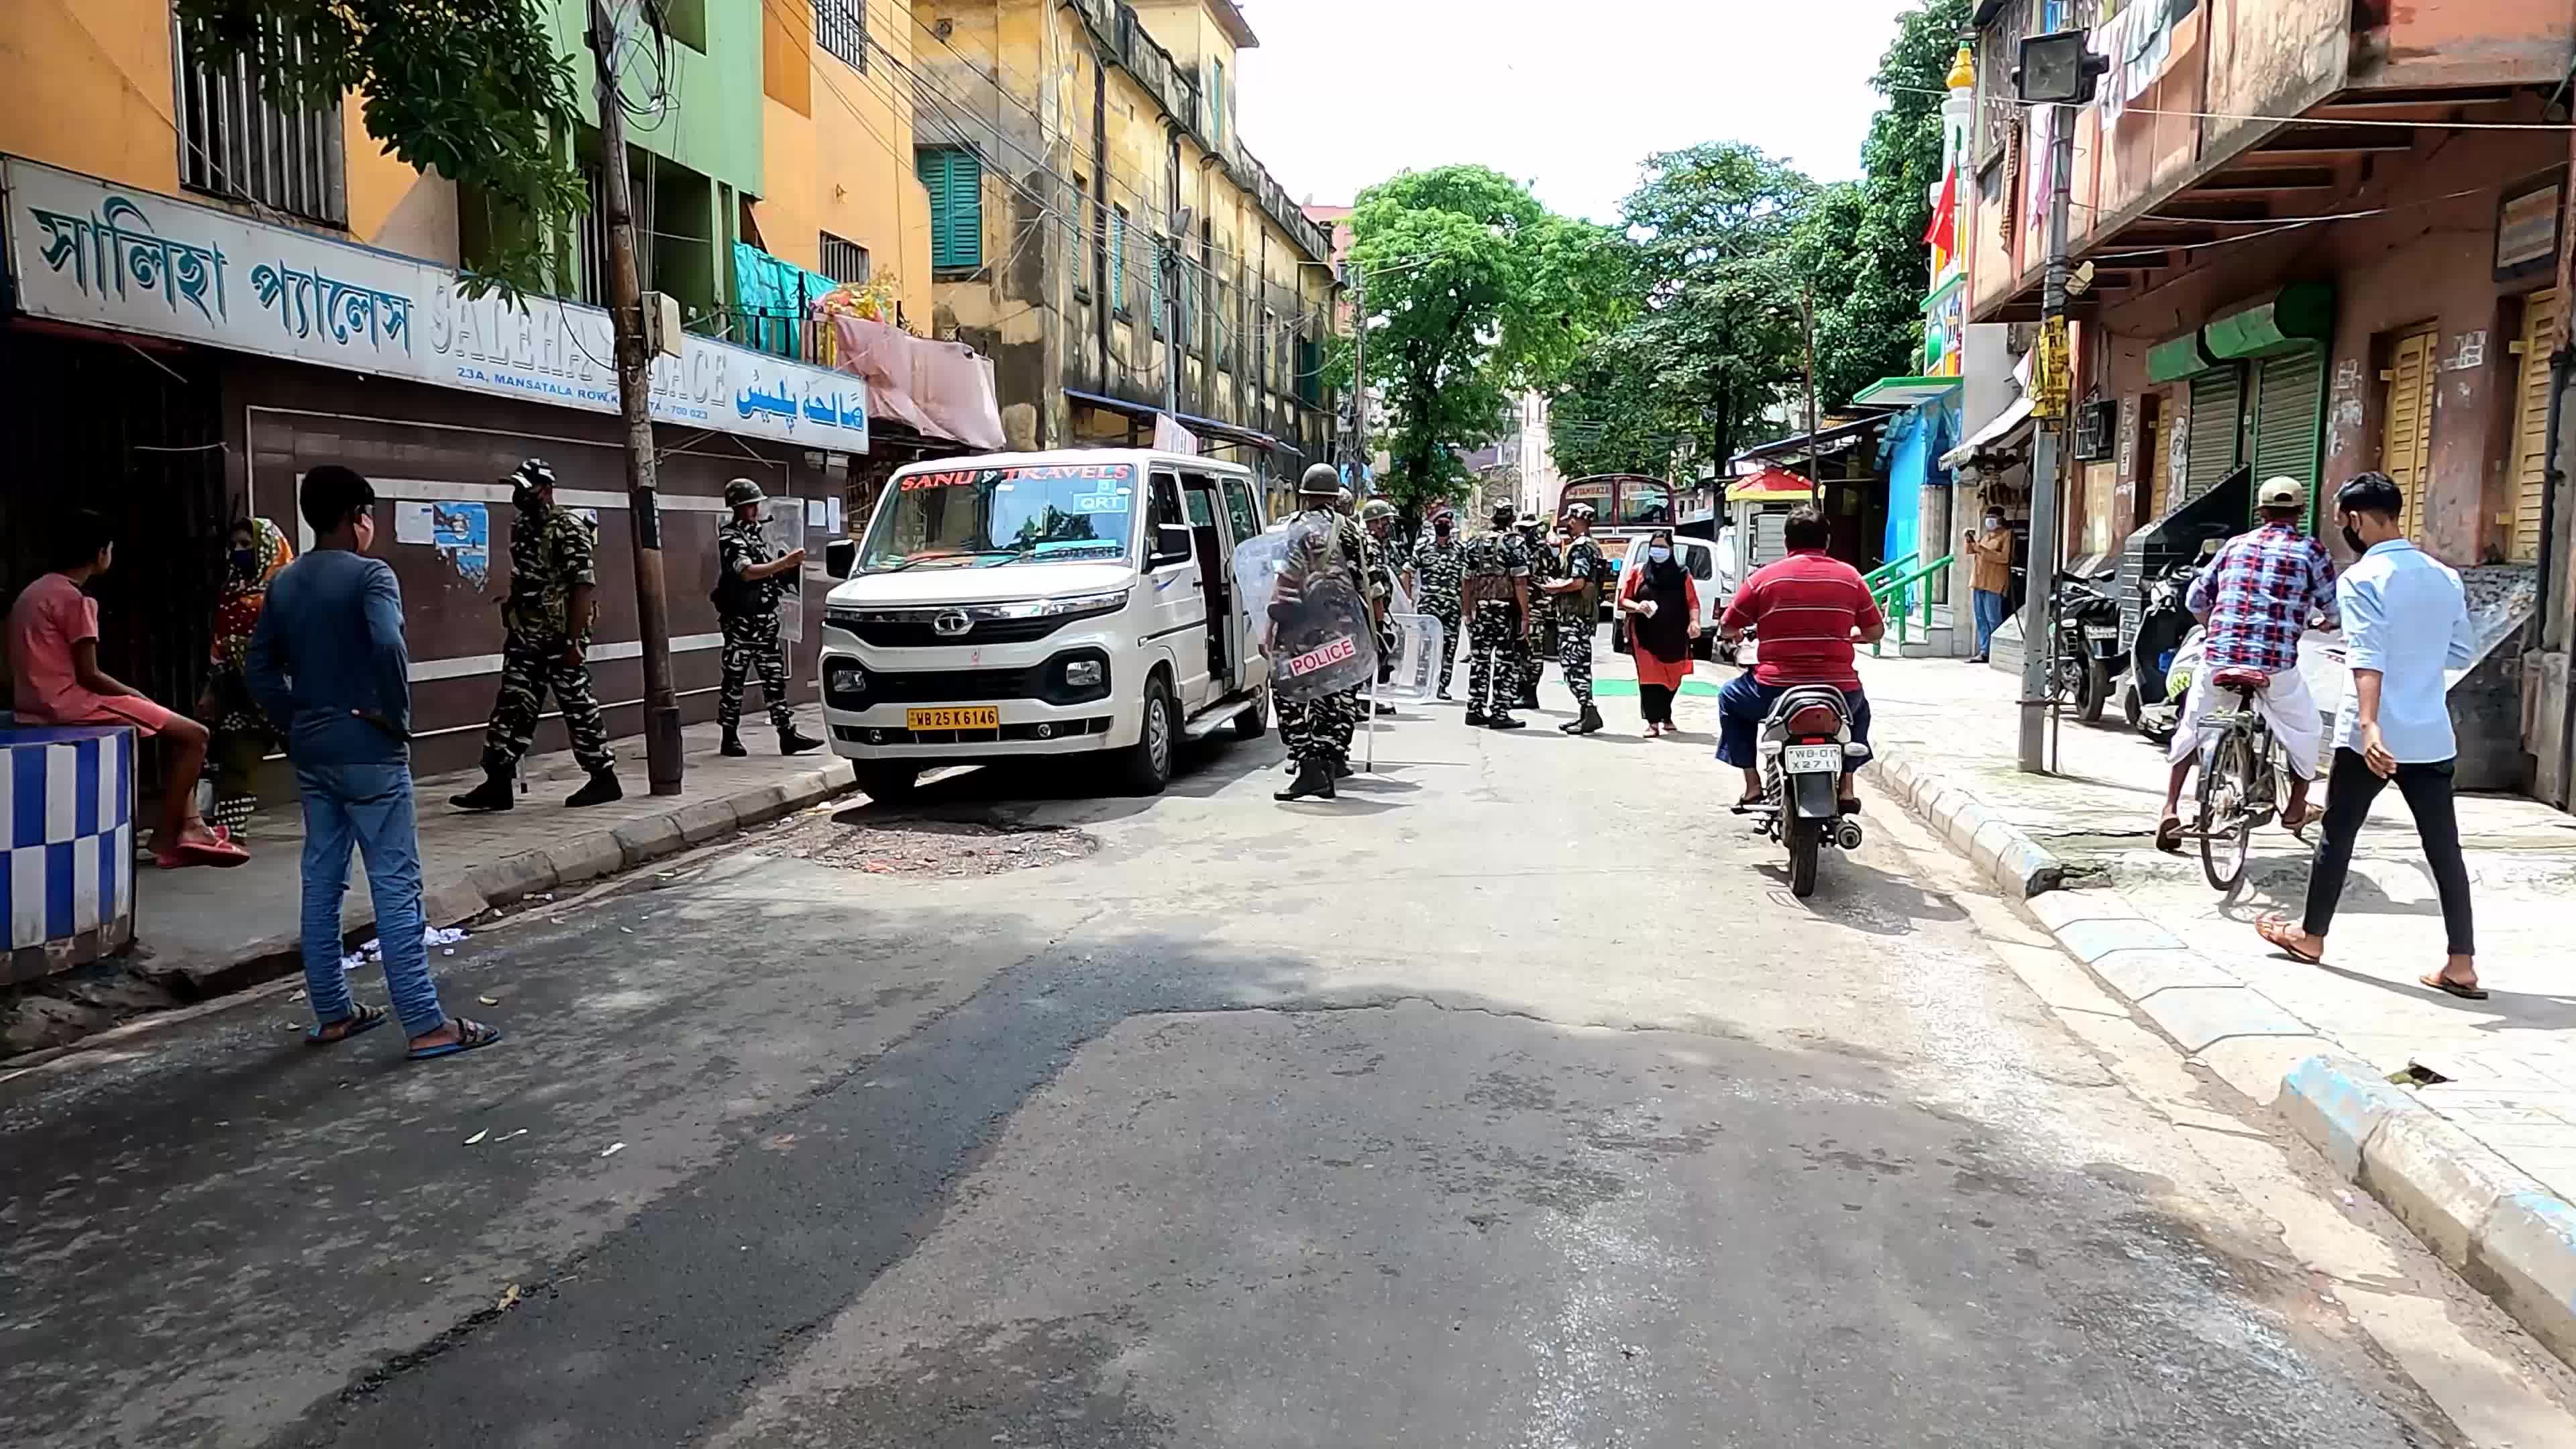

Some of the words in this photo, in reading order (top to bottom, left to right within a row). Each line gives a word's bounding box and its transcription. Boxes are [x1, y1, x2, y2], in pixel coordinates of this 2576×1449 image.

[251, 258, 415, 358] প্যালেস
[494, 374, 573, 396] MANSATALA
[901, 470, 977, 491] SANU
[1002, 466, 1128, 482] TRAVELS
[1080, 496, 1121, 510] QRT
[1292, 640, 1354, 674] POLICE
